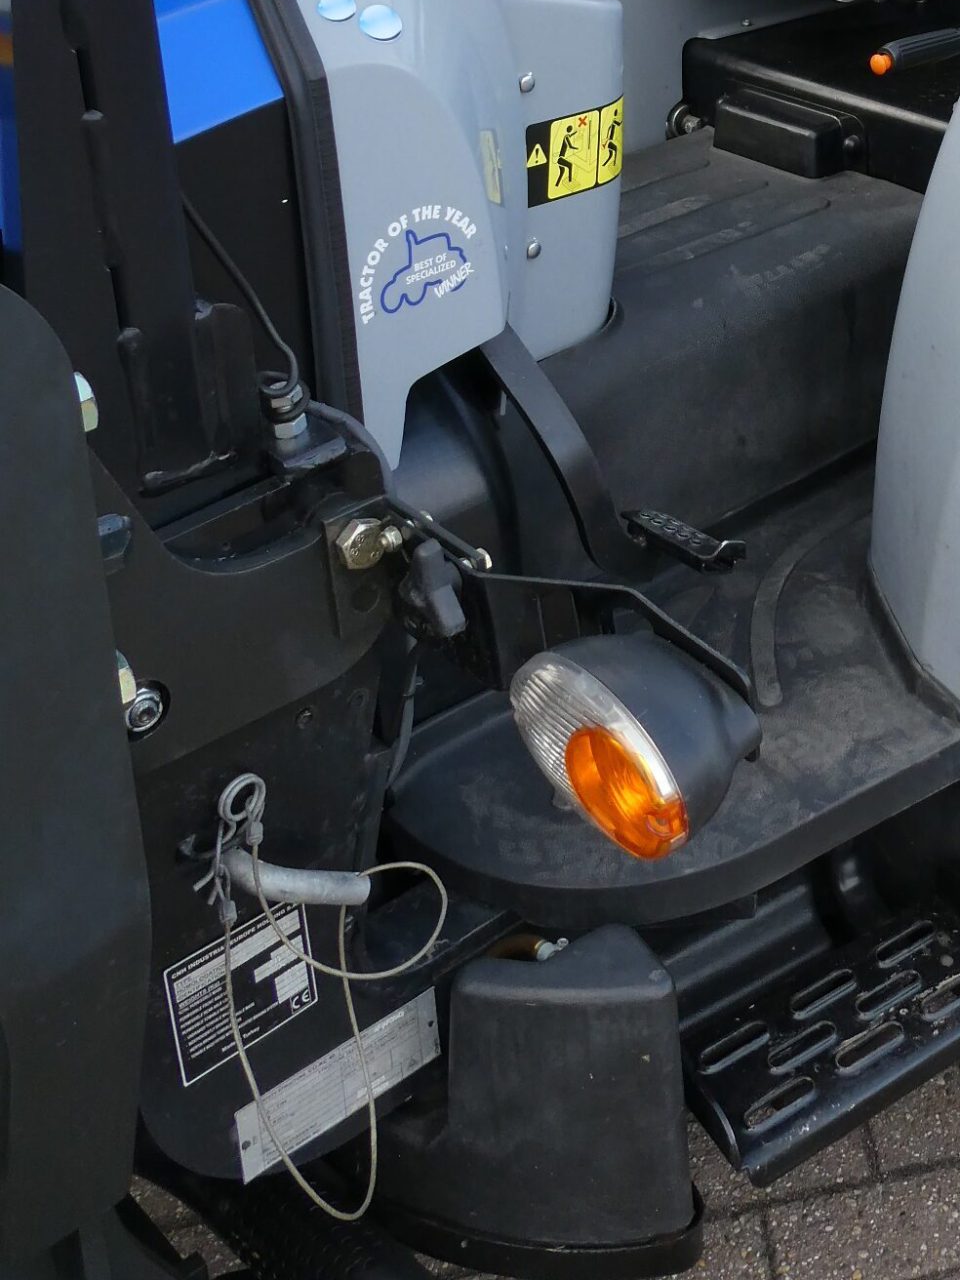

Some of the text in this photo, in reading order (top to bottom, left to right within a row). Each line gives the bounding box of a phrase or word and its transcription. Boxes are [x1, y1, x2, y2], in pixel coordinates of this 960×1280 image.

[359, 205, 477, 325] TRACTOR OF THE YEAR
[406, 260, 457, 285] SPECIALIZED
[414, 253, 448, 272] BEST OF
[434, 262, 474, 298] WINNER
[187, 944, 226, 970] INDUSTRIA
